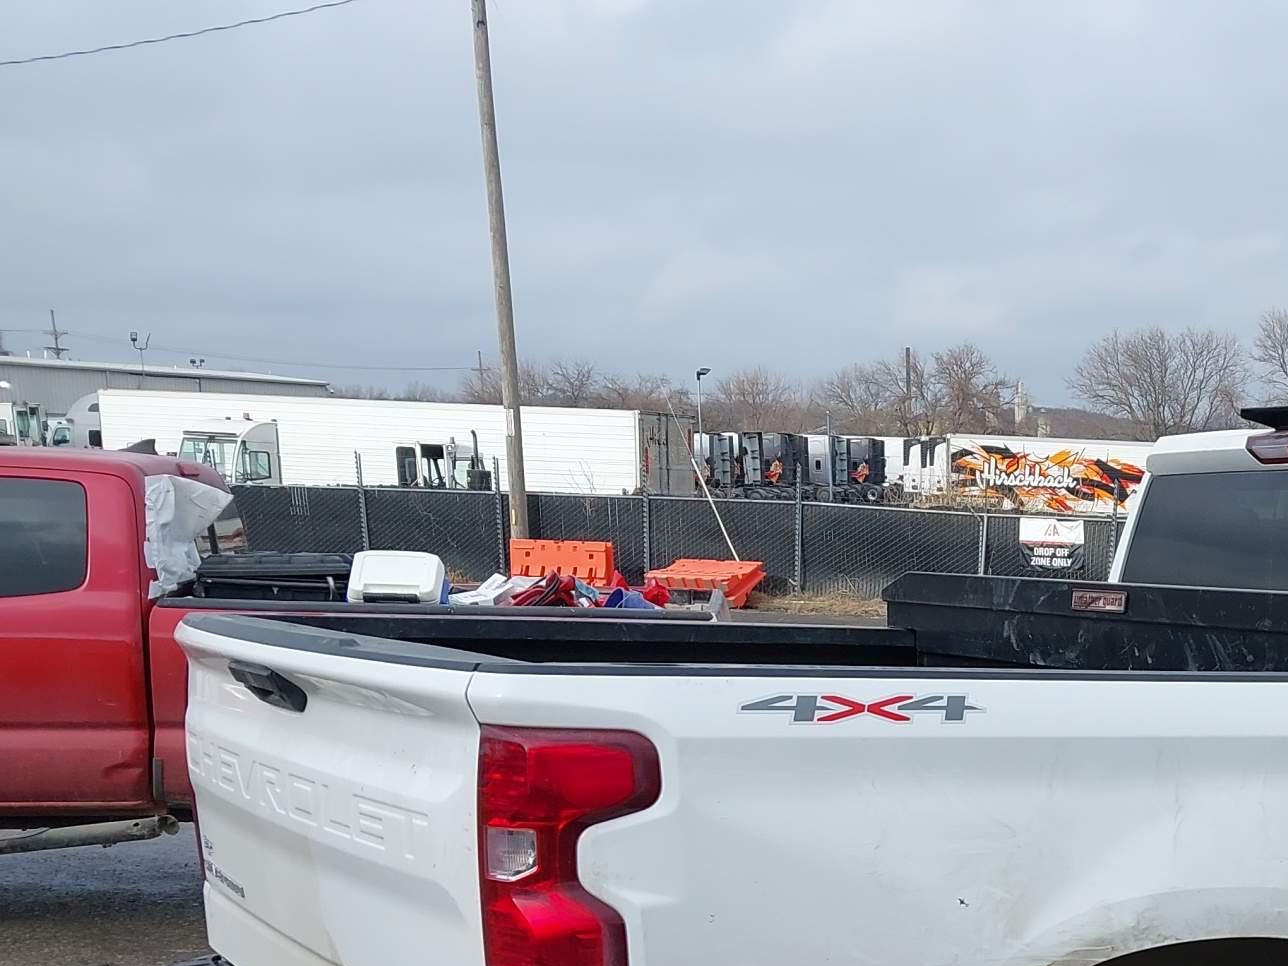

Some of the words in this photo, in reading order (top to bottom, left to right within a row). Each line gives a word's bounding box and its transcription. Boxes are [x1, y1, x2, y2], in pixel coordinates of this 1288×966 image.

[976, 457, 1078, 489] Hirschbach
[1031, 556, 1052, 566] ZONE
[1052, 557, 1073, 567] ONLY
[1033, 547, 1055, 557] DROP
[1055, 548, 1070, 557] OFF
[188, 728, 430, 860] CHEVROLET
